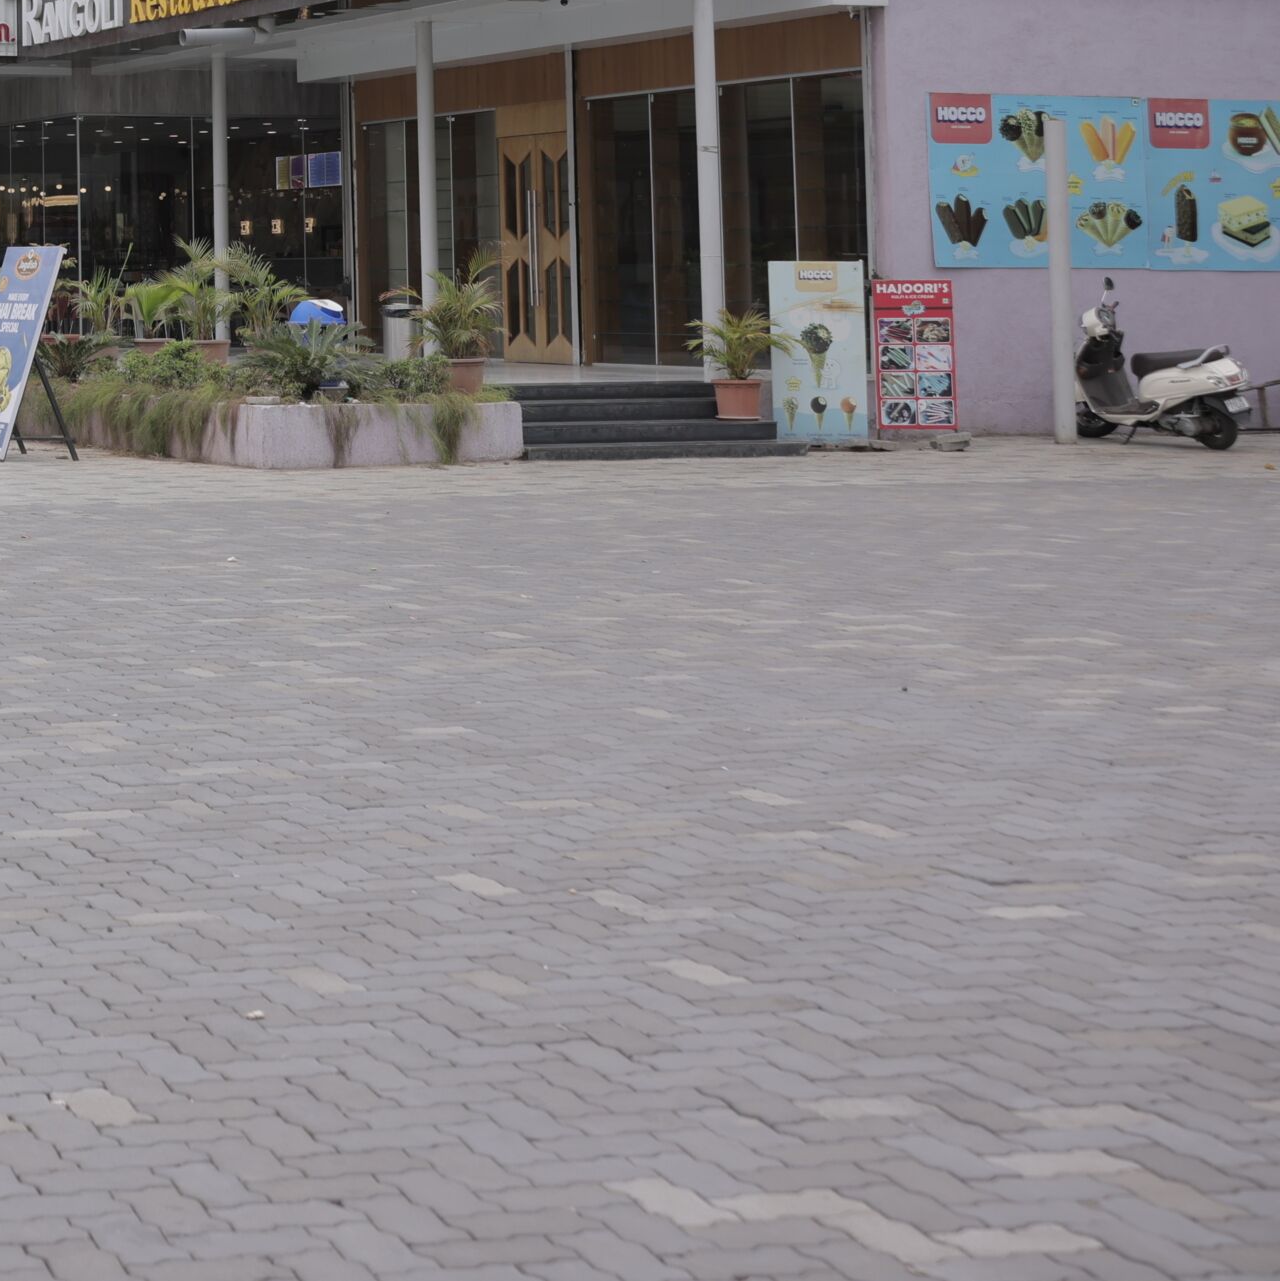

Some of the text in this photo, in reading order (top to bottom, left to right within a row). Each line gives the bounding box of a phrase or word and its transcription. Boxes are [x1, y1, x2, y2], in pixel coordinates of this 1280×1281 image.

[936, 106, 986, 123] HOCCO
[1154, 111, 1204, 128] HOCCO
[799, 269, 833, 280] HOCCO
[876, 282, 949, 295] HAJOORI'S
[10, 303, 39, 321] BREAK
